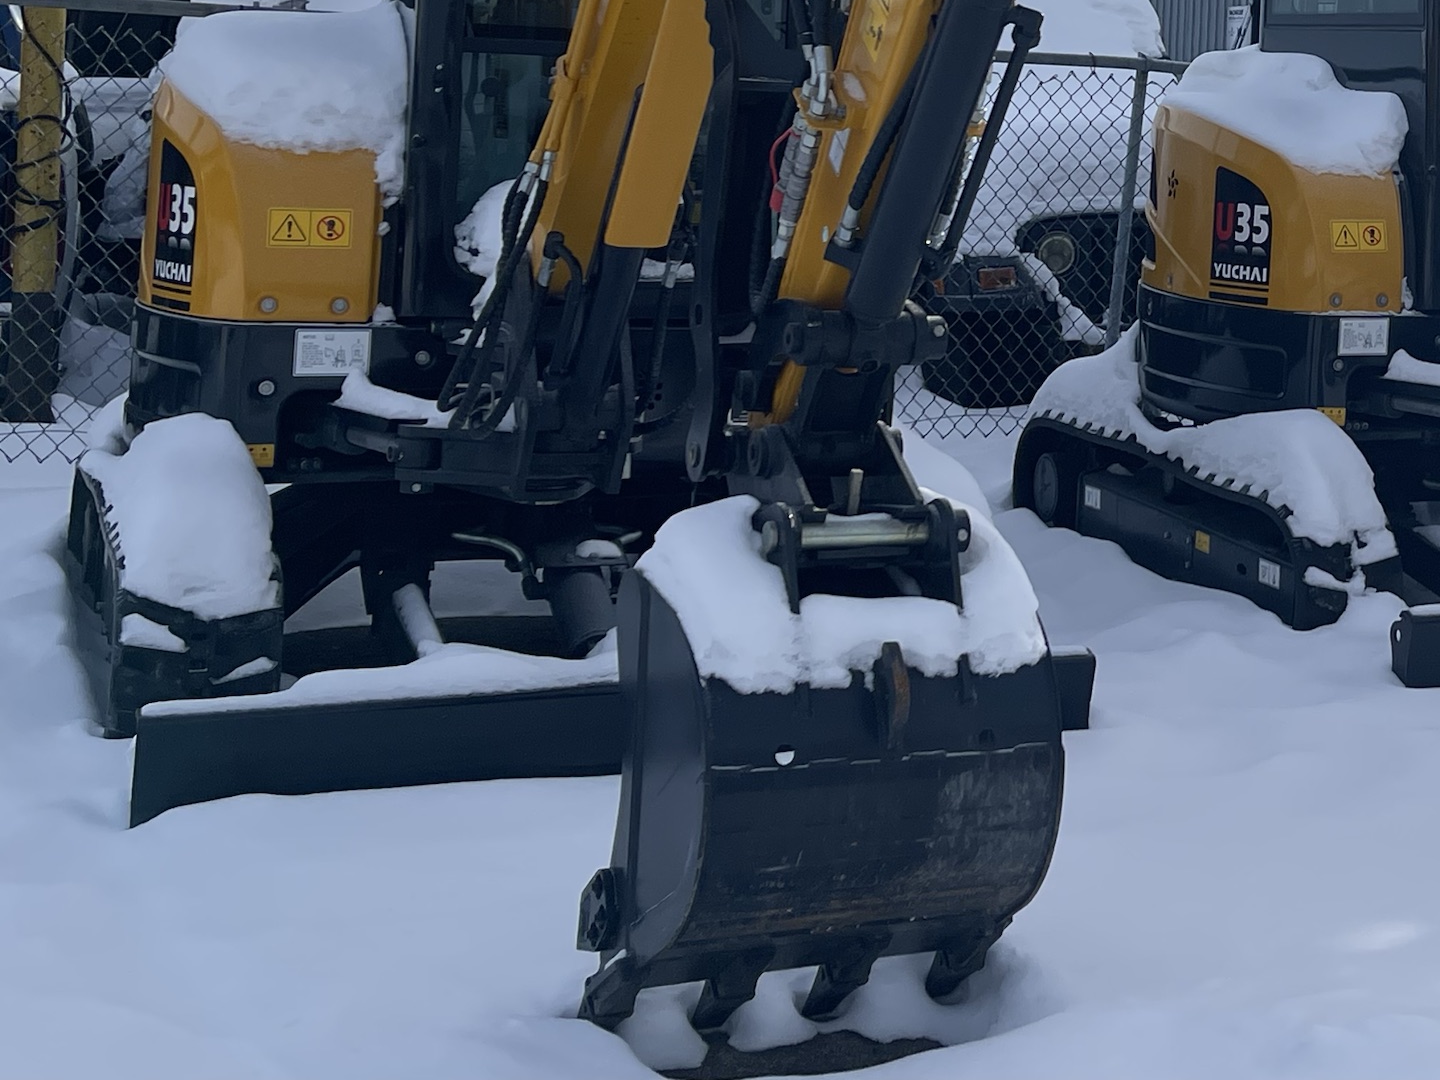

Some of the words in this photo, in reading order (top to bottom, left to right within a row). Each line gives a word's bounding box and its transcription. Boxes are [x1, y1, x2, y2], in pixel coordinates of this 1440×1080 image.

[158, 183, 196, 234] U35
[1216, 201, 1269, 244] U35
[155, 259, 191, 282] YUCHAI
[1214, 262, 1267, 282] YUCHAI
